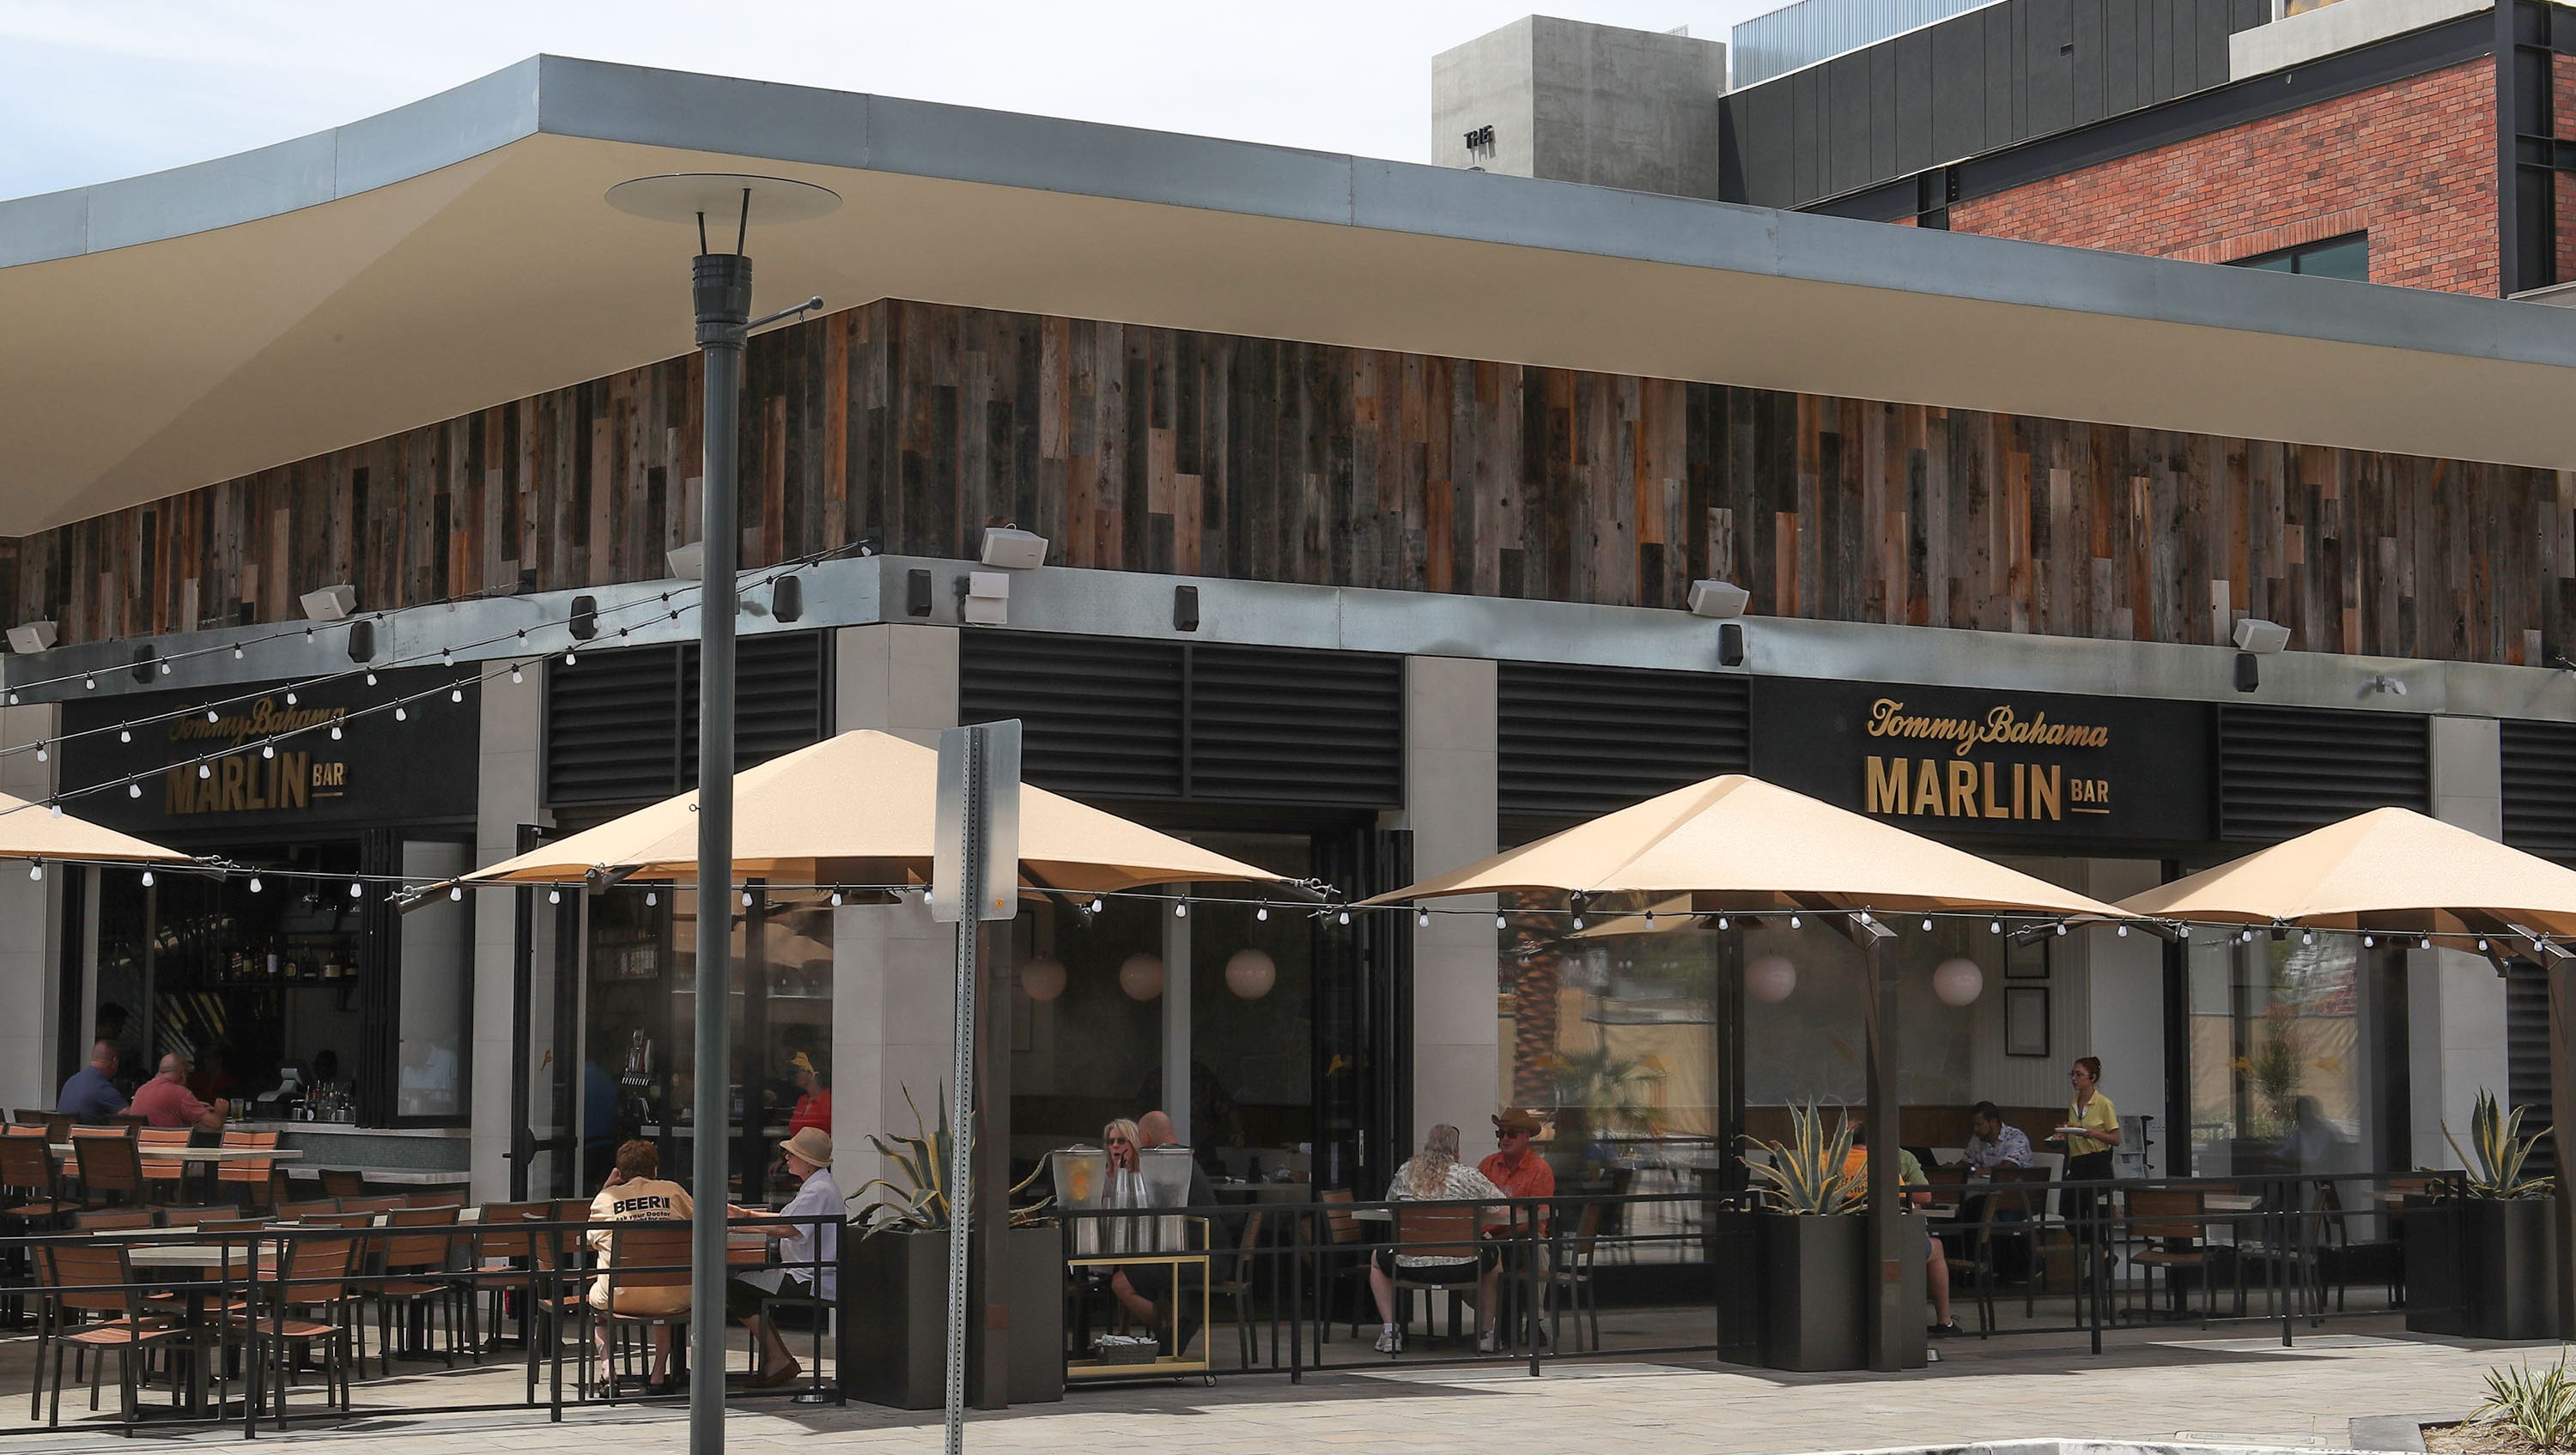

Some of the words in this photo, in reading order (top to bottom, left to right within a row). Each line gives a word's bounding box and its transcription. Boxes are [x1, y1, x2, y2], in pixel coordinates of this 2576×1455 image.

[170, 704, 248, 746] Tommy
[247, 696, 348, 735] Bahama
[1868, 698, 1977, 756] Tommy
[1976, 705, 2109, 748] Bahama
[165, 751, 310, 815] MARLIN
[313, 762, 346, 786] BAR
[1865, 755, 2062, 821] MARLIN
[2070, 778, 2110, 803] BAR
